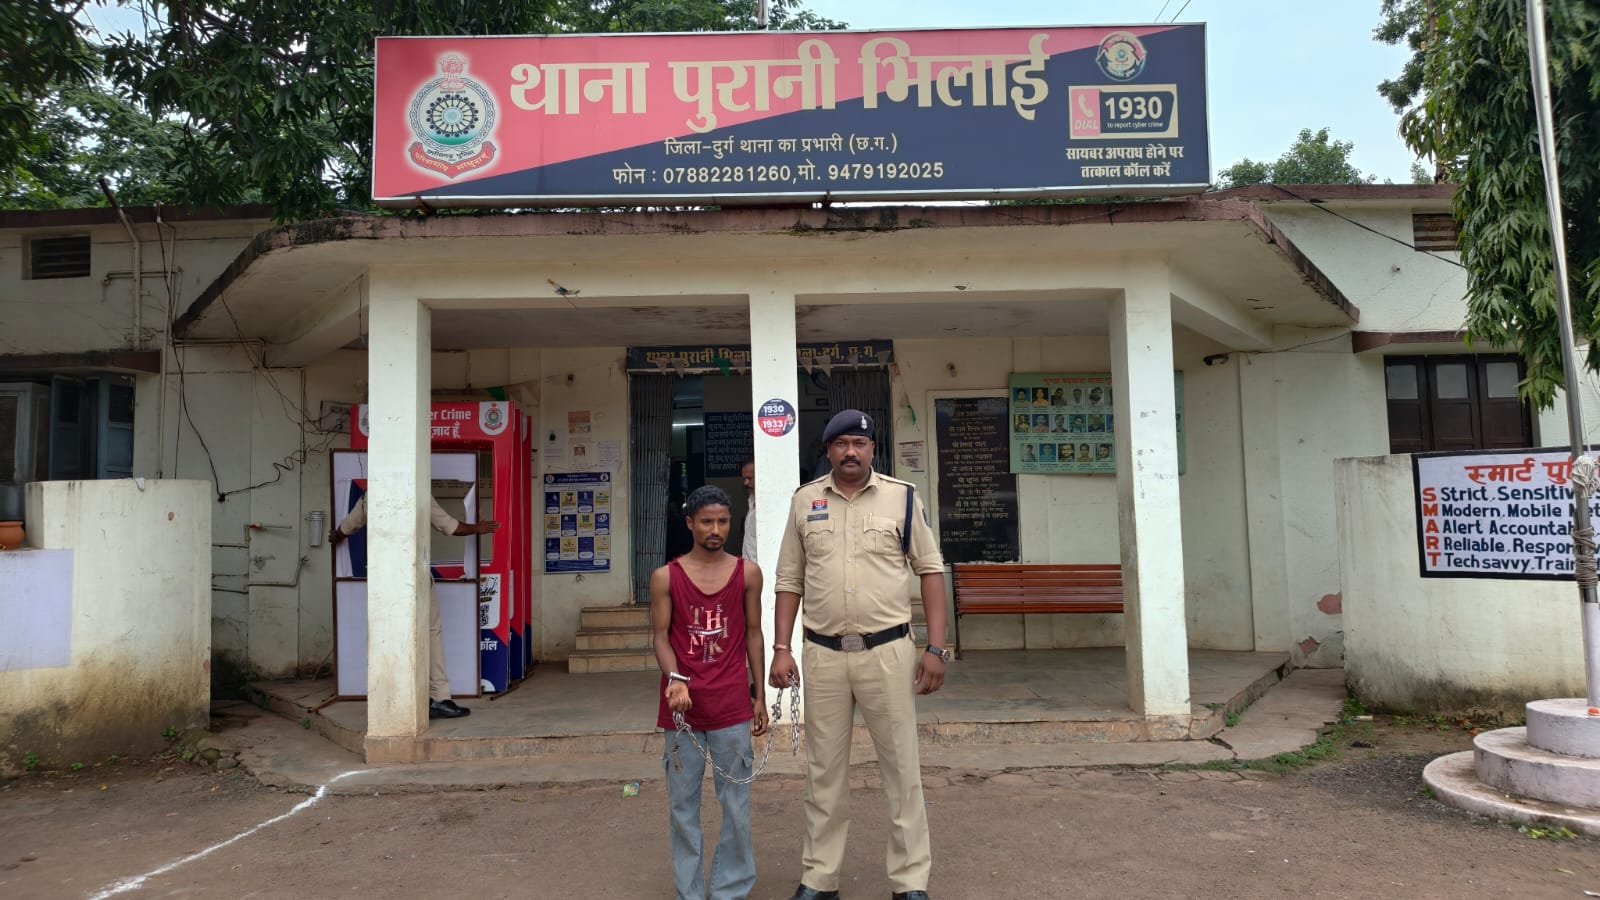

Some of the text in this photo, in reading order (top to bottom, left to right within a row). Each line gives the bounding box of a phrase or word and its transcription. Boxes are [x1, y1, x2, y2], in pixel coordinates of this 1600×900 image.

[510, 33, 1050, 133] थाना पुरानी भिलाई
[1105, 96, 1163, 120] 1930
[1074, 120, 1099, 130] DIAL
[664, 132, 898, 159] जिला-दुर्ग थाना का प्रभारी (छ.ग.)
[1065, 143, 1185, 160] सायबर अपराध होने पर
[828, 162, 944, 181] 9479192025
[1080, 161, 1171, 178] तत्काल कॉल करें
[441, 408, 472, 420] Crime
[763, 404, 785, 414] 1930
[763, 419, 784, 429] 1933
[1464, 457, 1536, 485] स्मार्ट
[1497, 485, 1577, 501] Sensitiv
[1507, 503, 1562, 518] Mobile
[1443, 519, 1484, 535] Alert
